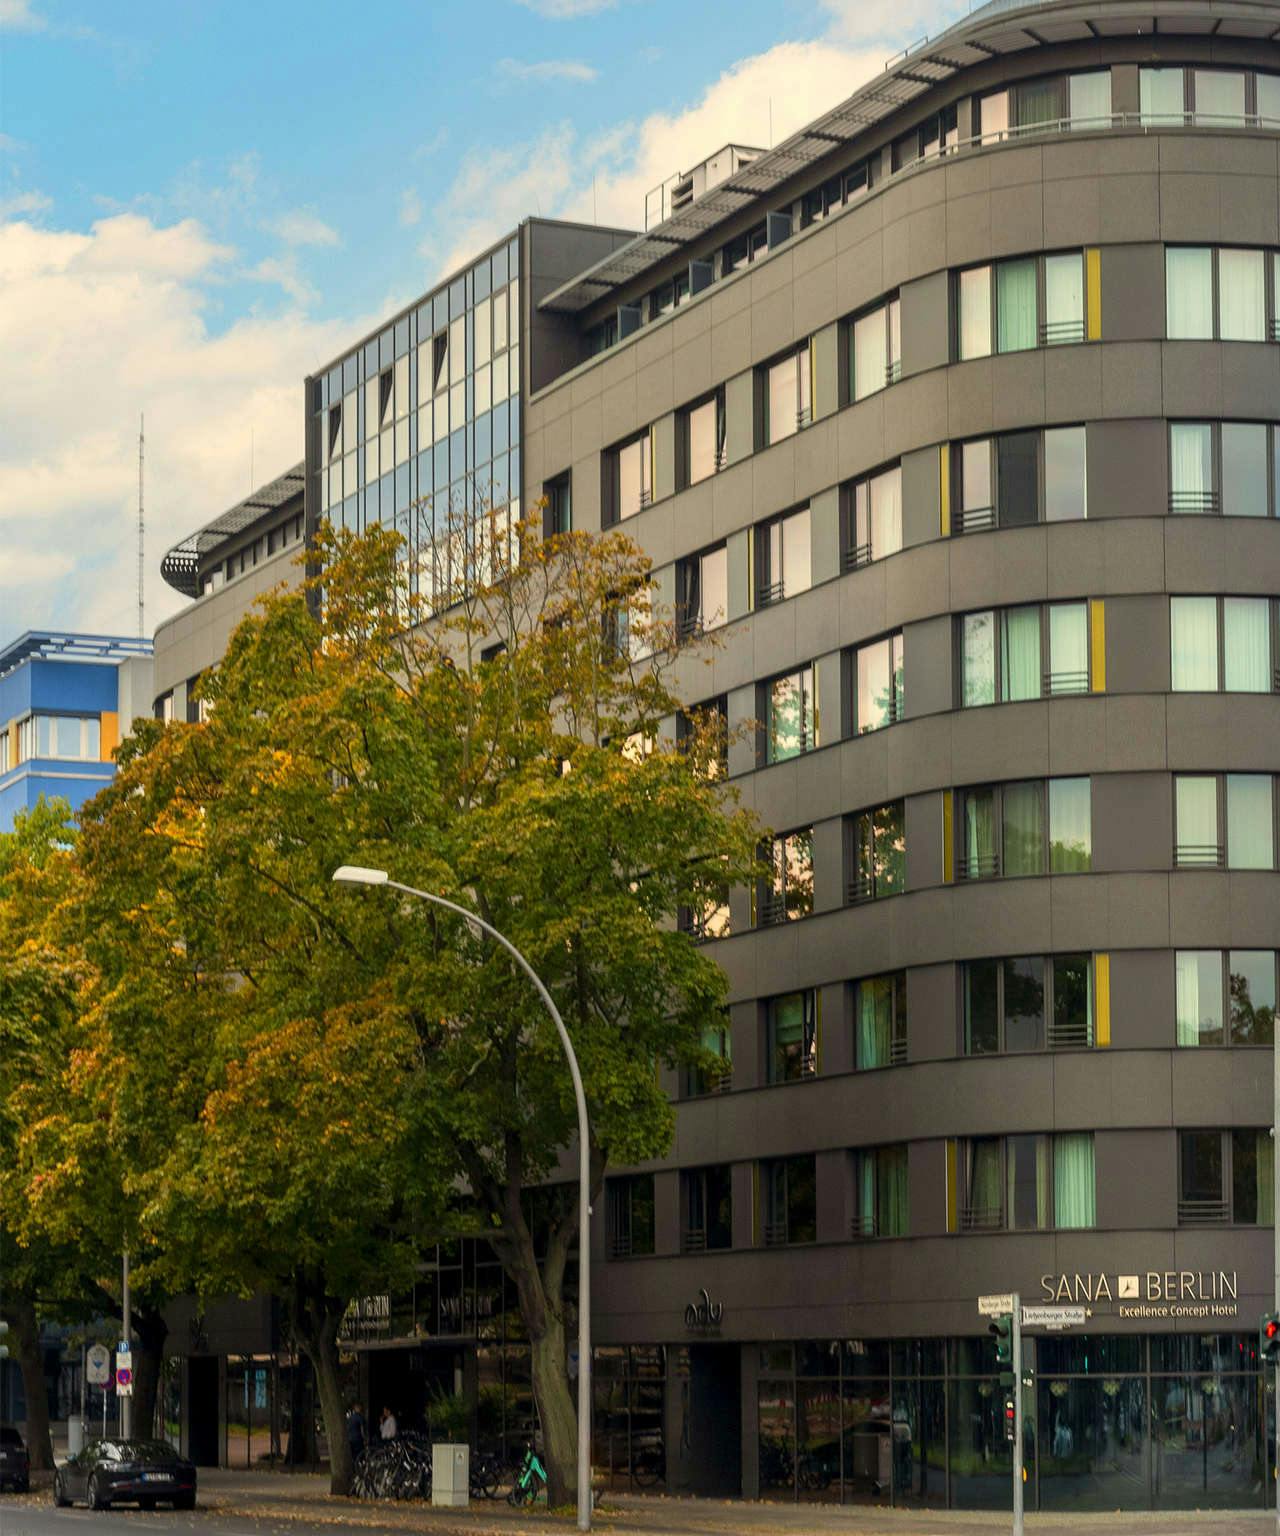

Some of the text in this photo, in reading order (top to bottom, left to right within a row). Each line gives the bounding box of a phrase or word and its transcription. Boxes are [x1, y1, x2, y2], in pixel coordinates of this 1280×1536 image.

[1040, 1271, 1237, 1302] SANA BERLIN
[1119, 1304, 1237, 1318] Excellence Concept Hotel
